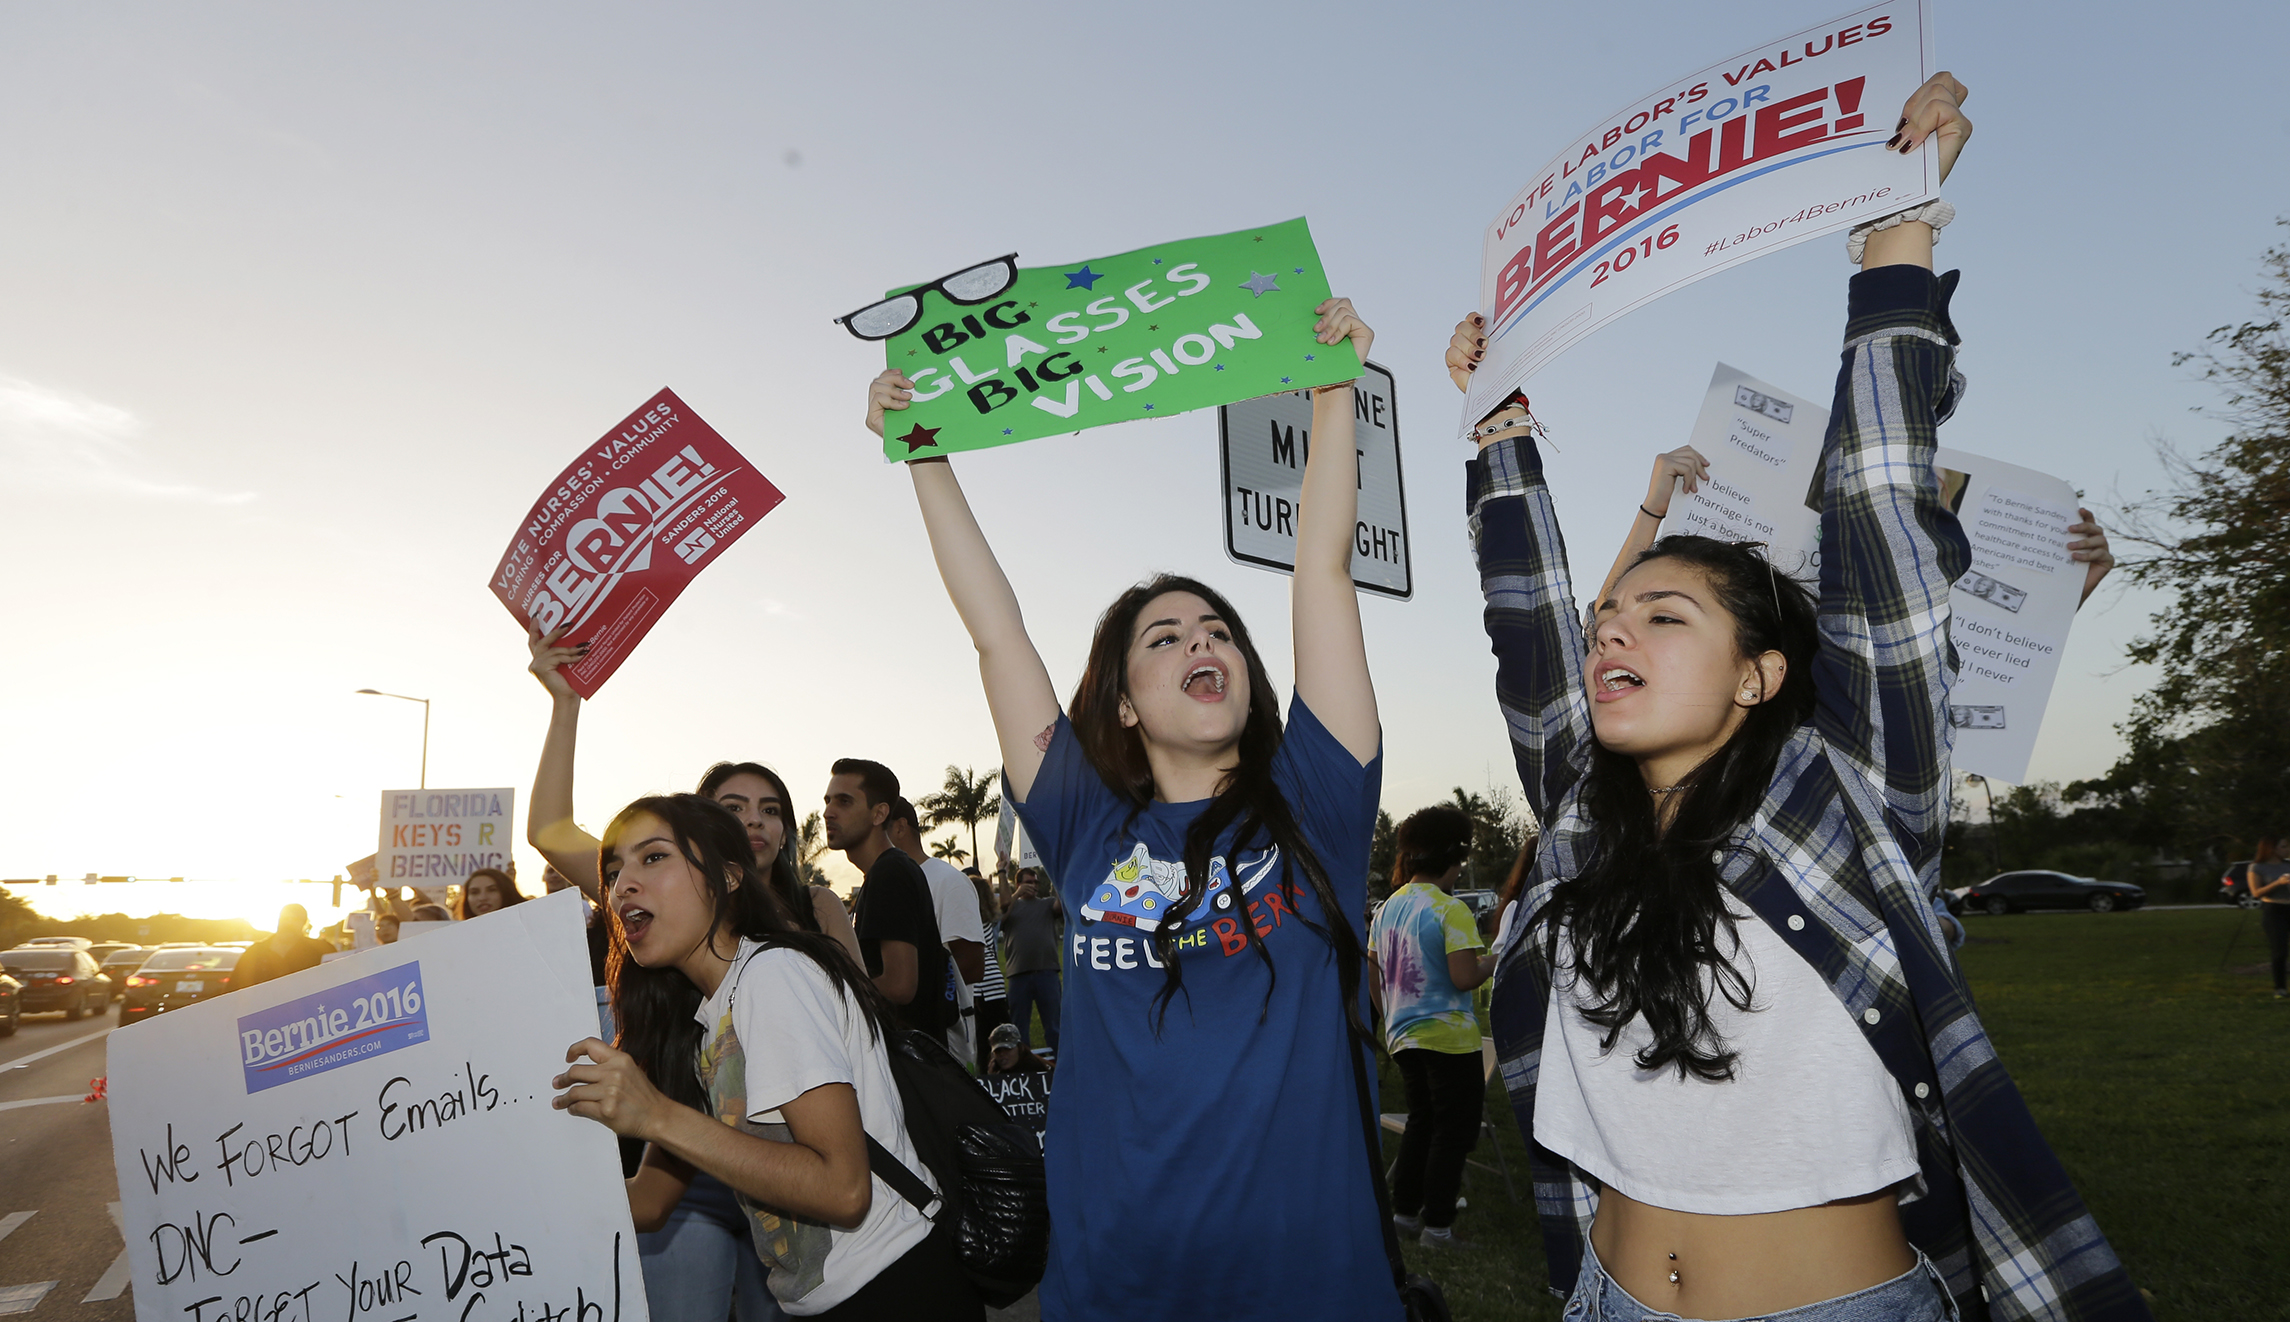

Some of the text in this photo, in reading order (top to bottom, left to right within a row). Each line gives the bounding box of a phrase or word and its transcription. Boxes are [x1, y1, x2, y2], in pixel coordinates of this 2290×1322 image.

[1496, 15, 1892, 241] VOTE LABOR'S VALUES
[1545, 84, 1771, 221] LABOR FOR
[1493, 75, 1866, 324] BERNIE!
[1704, 186, 1891, 257] #Labor4Bernie
[1590, 223, 1680, 289] 2016
[905, 262, 1211, 403] GLASSES
[921, 300, 1032, 355] BIG
[967, 352, 1084, 415] BIG
[1030, 313, 1263, 418] VISION
[1354, 387, 1386, 429] NE
[1271, 419, 1364, 490] MT
[498, 402, 672, 589] VOTE NURSES' VALUES
[507, 413, 680, 600] CARING COMPASSION COMMUNITY
[703, 497, 739, 527] National
[1237, 486, 1299, 537] TUR
[1711, 479, 1751, 505] believe
[2005, 498, 2033, 512] Bernie
[2034, 506, 2067, 522] Sanders
[661, 486, 728, 545] SANDERS 2016
[709, 508, 739, 533] Nurses
[715, 514, 744, 539] United
[1686, 510, 1709, 527] just
[1709, 522, 1717, 531] a
[1693, 494, 1774, 535] marriage is not
[1979, 518, 2065, 549] commitment to real
[1983, 507, 2069, 537] with thanks for your
[528, 444, 716, 637] BERNIE!
[1356, 521, 1400, 564] GHT
[1971, 543, 2055, 574] Americans and best
[1974, 531, 2020, 550] healthcare
[2021, 544, 2050, 559] access
[2052, 550, 2065, 564] for
[521, 550, 563, 610] NURSES FOR
[1972, 558, 2000, 570] ishes"
[1967, 621, 2002, 639] don't
[2005, 631, 2053, 655] believe
[1973, 644, 2003, 660] ever
[2005, 652, 2030, 669] lied
[1976, 666, 2014, 684] never
[391, 793, 503, 819] FLORIDA
[392, 822, 495, 848] KEYS R
[390, 852, 503, 878] BERNING
[1073, 934, 1165, 970] FEEL
[1171, 928, 1208, 950] HE
[242, 981, 422, 1064] Bernie 2016
[288, 1040, 382, 1076] BERNIESANDERS.COM
[1002, 1101, 1046, 1117] TTER
[140, 1123, 199, 1195] We
[216, 1111, 358, 1187] FORGOT
[420, 1230, 533, 1303] Data
